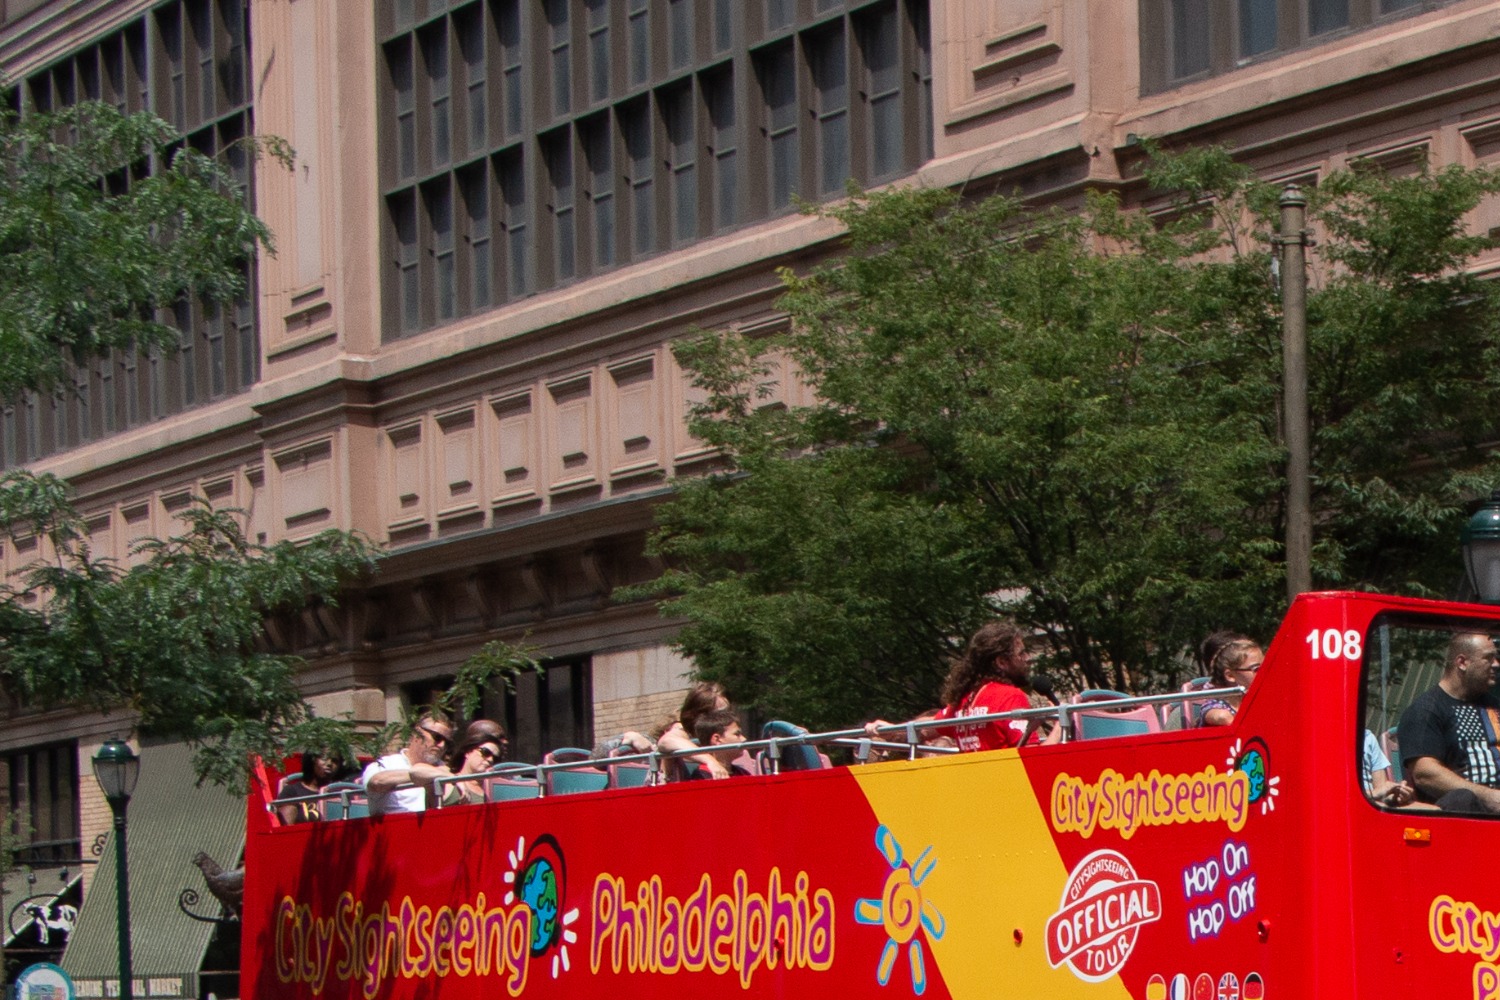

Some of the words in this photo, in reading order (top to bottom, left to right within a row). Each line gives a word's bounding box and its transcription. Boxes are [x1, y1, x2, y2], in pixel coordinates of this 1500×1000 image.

[1306, 629, 1362, 661] 108
[1183, 859, 1220, 897] Hop
[1223, 842, 1249, 876] On
[590, 866, 836, 990] Philadelphia
[1056, 886, 1155, 954] OFFICIAL
[1188, 902, 1224, 940] Hop
[1228, 877, 1256, 917] Off
[1085, 934, 1131, 972] TOUR
[72, 981, 103, 997] EADING
